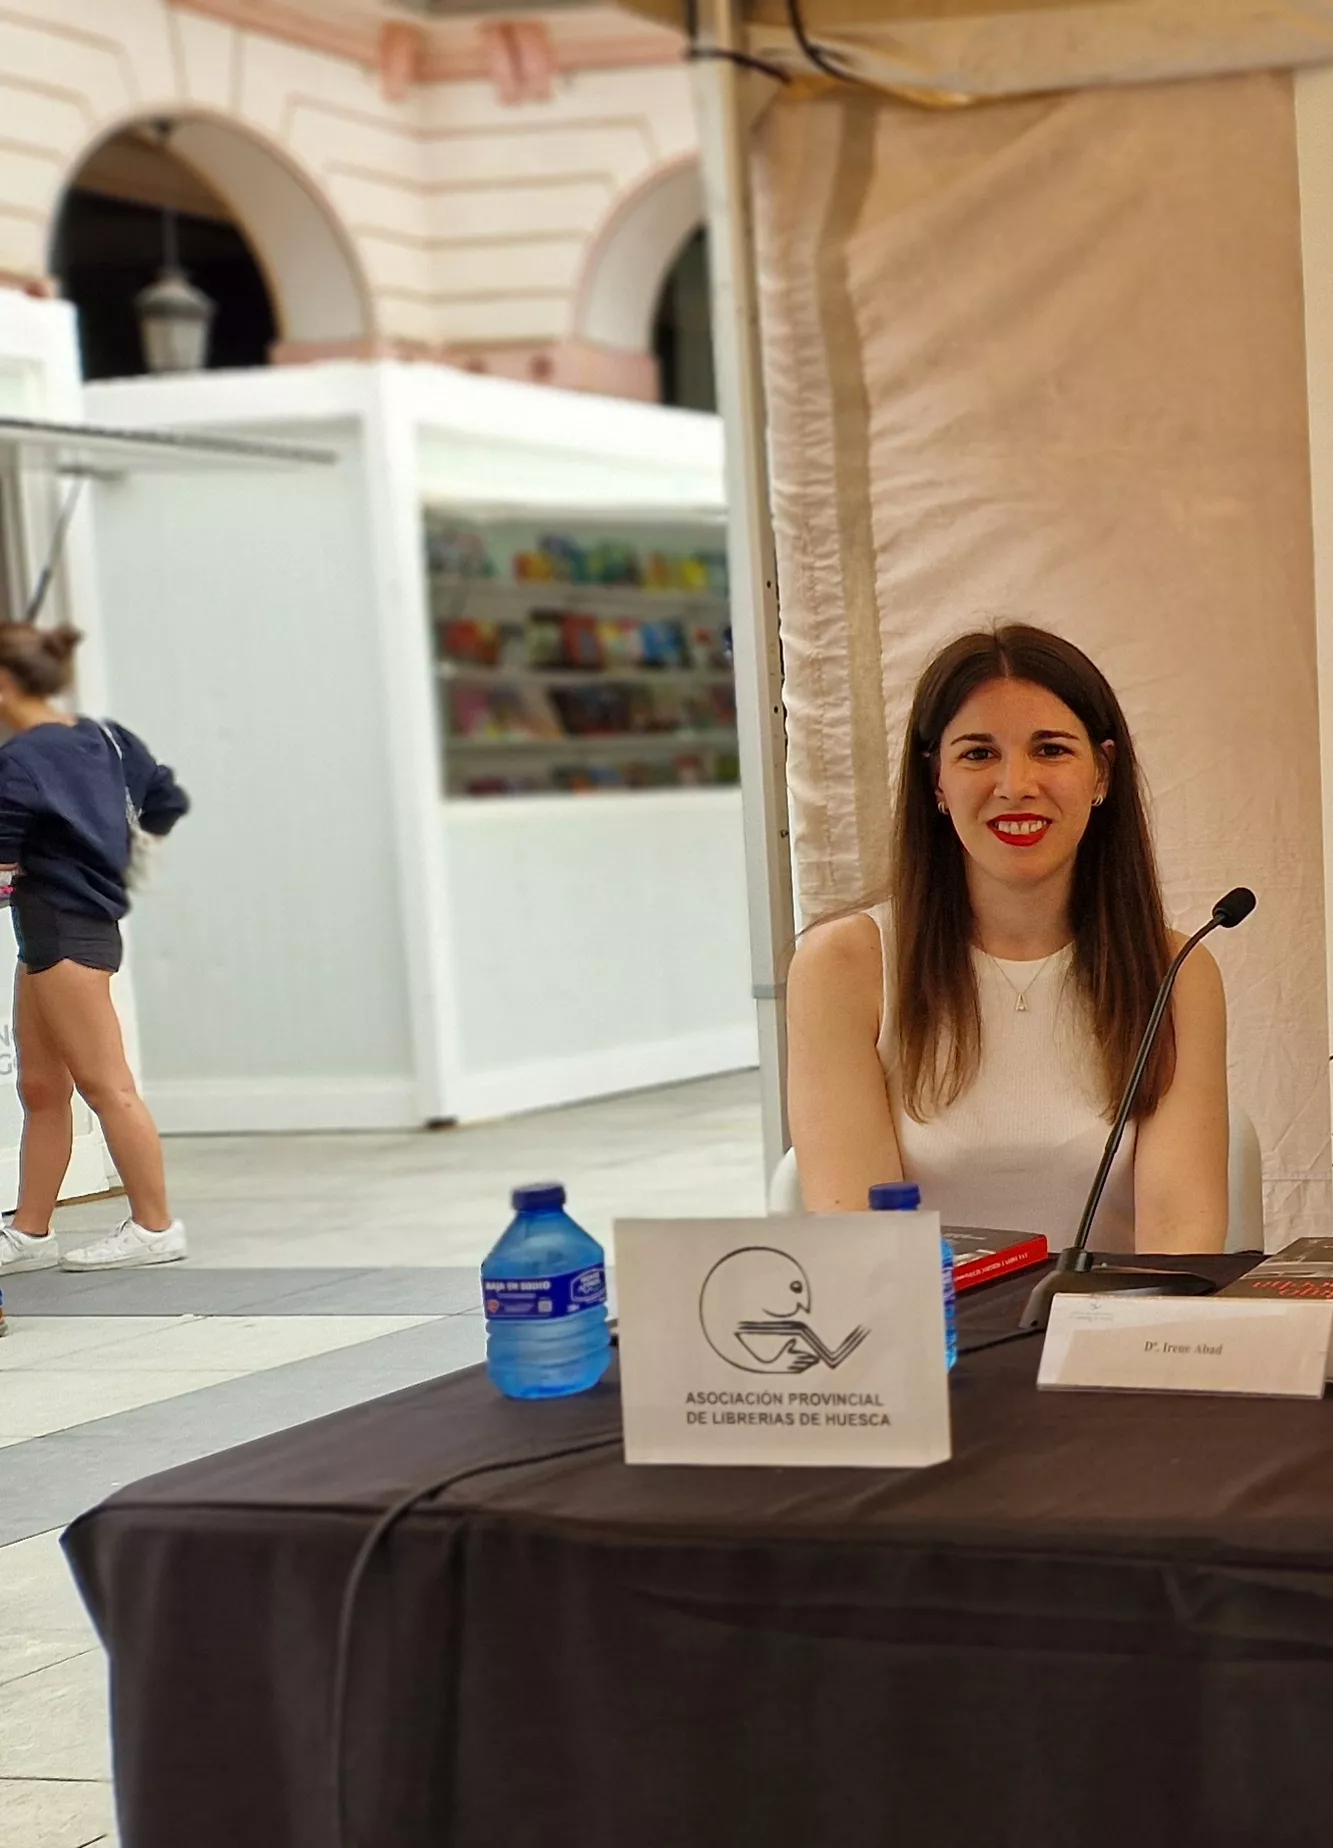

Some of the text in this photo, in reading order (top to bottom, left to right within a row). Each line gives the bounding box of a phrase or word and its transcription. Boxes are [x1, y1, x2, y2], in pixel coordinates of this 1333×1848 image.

[1163, 1342, 1191, 1354] Irene
[1194, 1344, 1223, 1356] Abad
[686, 1390, 884, 1407] ASOCIACIÓN PROVINCIAL
[686, 1411, 892, 1427] DE LIBRERIAS DE HUESCA
